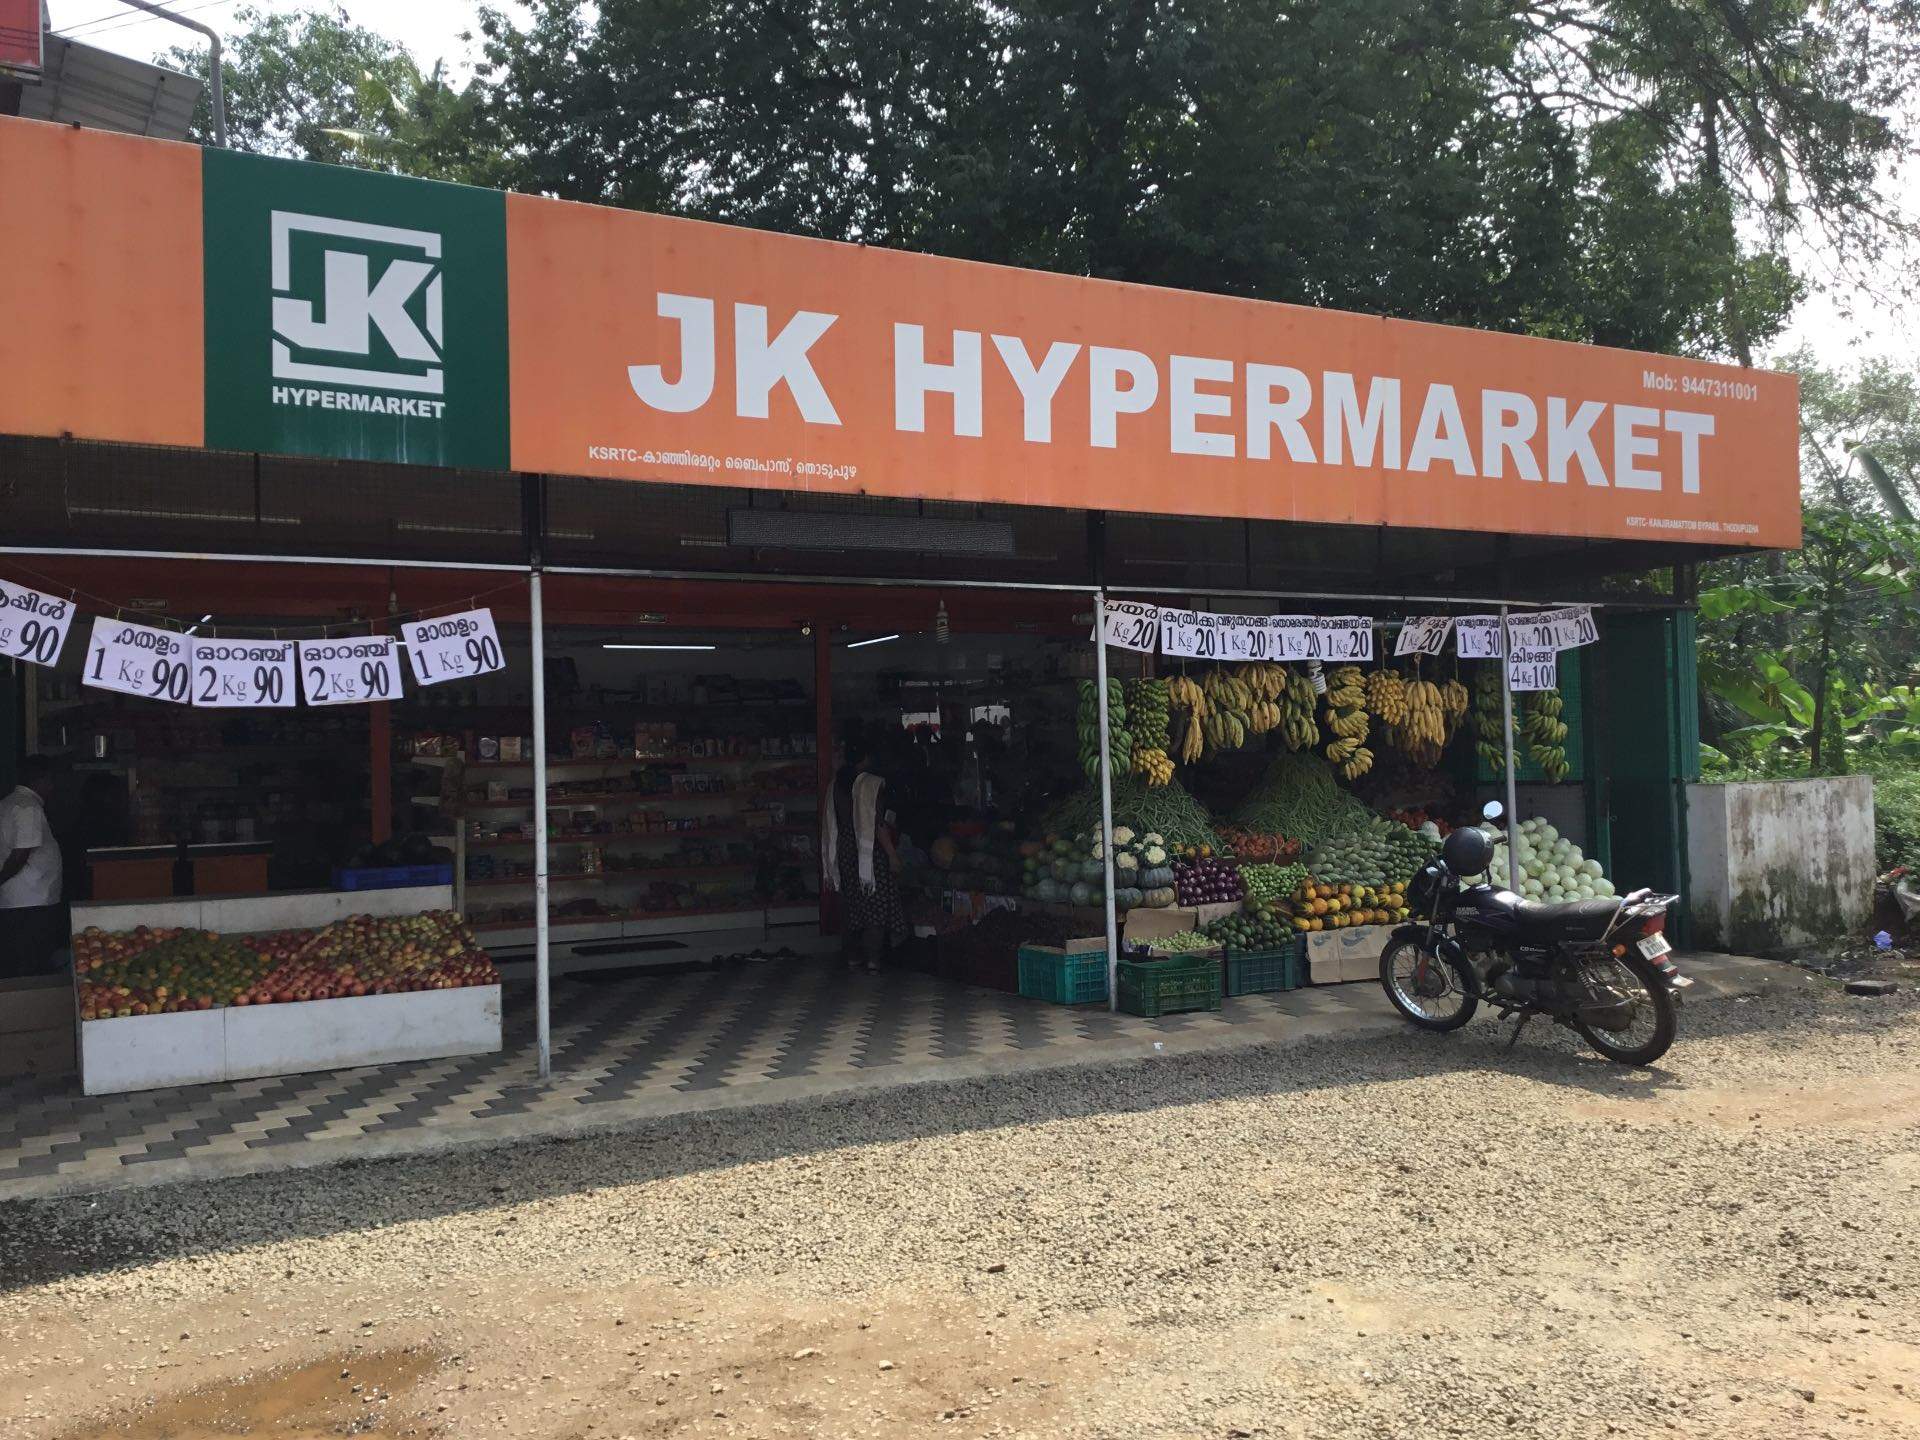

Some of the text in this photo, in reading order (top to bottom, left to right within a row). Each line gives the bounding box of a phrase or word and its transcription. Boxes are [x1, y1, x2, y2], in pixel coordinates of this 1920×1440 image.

[272, 249, 442, 363] JK
[628, 293, 1715, 494] JK HYPERMARKET
[1642, 370, 1758, 402] Mob: 9447311001
[272, 386, 446, 419] HYPERMARKET
[796, 461, 858, 480] തൊടുപുഴ
[14, 620, 59, 663] 90
[112, 628, 180, 657] ാതളം
[416, 618, 479, 643] മാതളം
[1112, 621, 1129, 643] Kg
[1128, 618, 1154, 649] 20
[1167, 627, 1215, 656] 1 Kg 20
[1221, 630, 1228, 654] 1
[1231, 635, 1246, 654] Kg
[1247, 630, 1266, 657] 20
[1277, 633, 1285, 656] 1
[1287, 636, 1303, 655] Kg
[1304, 631, 1321, 657] 20
[1327, 630, 1369, 657] 1 Kg 20
[1399, 631, 1408, 652] 1
[1417, 629, 1442, 652] 20
[1461, 632, 1468, 653] 1
[1485, 630, 1499, 655] 30
[1533, 626, 1552, 646] 20
[1554, 627, 1562, 646] 1
[1575, 617, 1594, 643] 20
[196, 643, 292, 663] ഓറഞ്ച്
[304, 637, 395, 661] ഓറഞ്ച്
[415, 634, 499, 679] 1 Kg 90
[91, 647, 188, 701] 1 Kg 90
[199, 665, 283, 704] 2 Kg 90
[308, 661, 390, 702] 2 Kg 90
[1511, 665, 1521, 688] 4
[1532, 664, 1555, 688] 100
